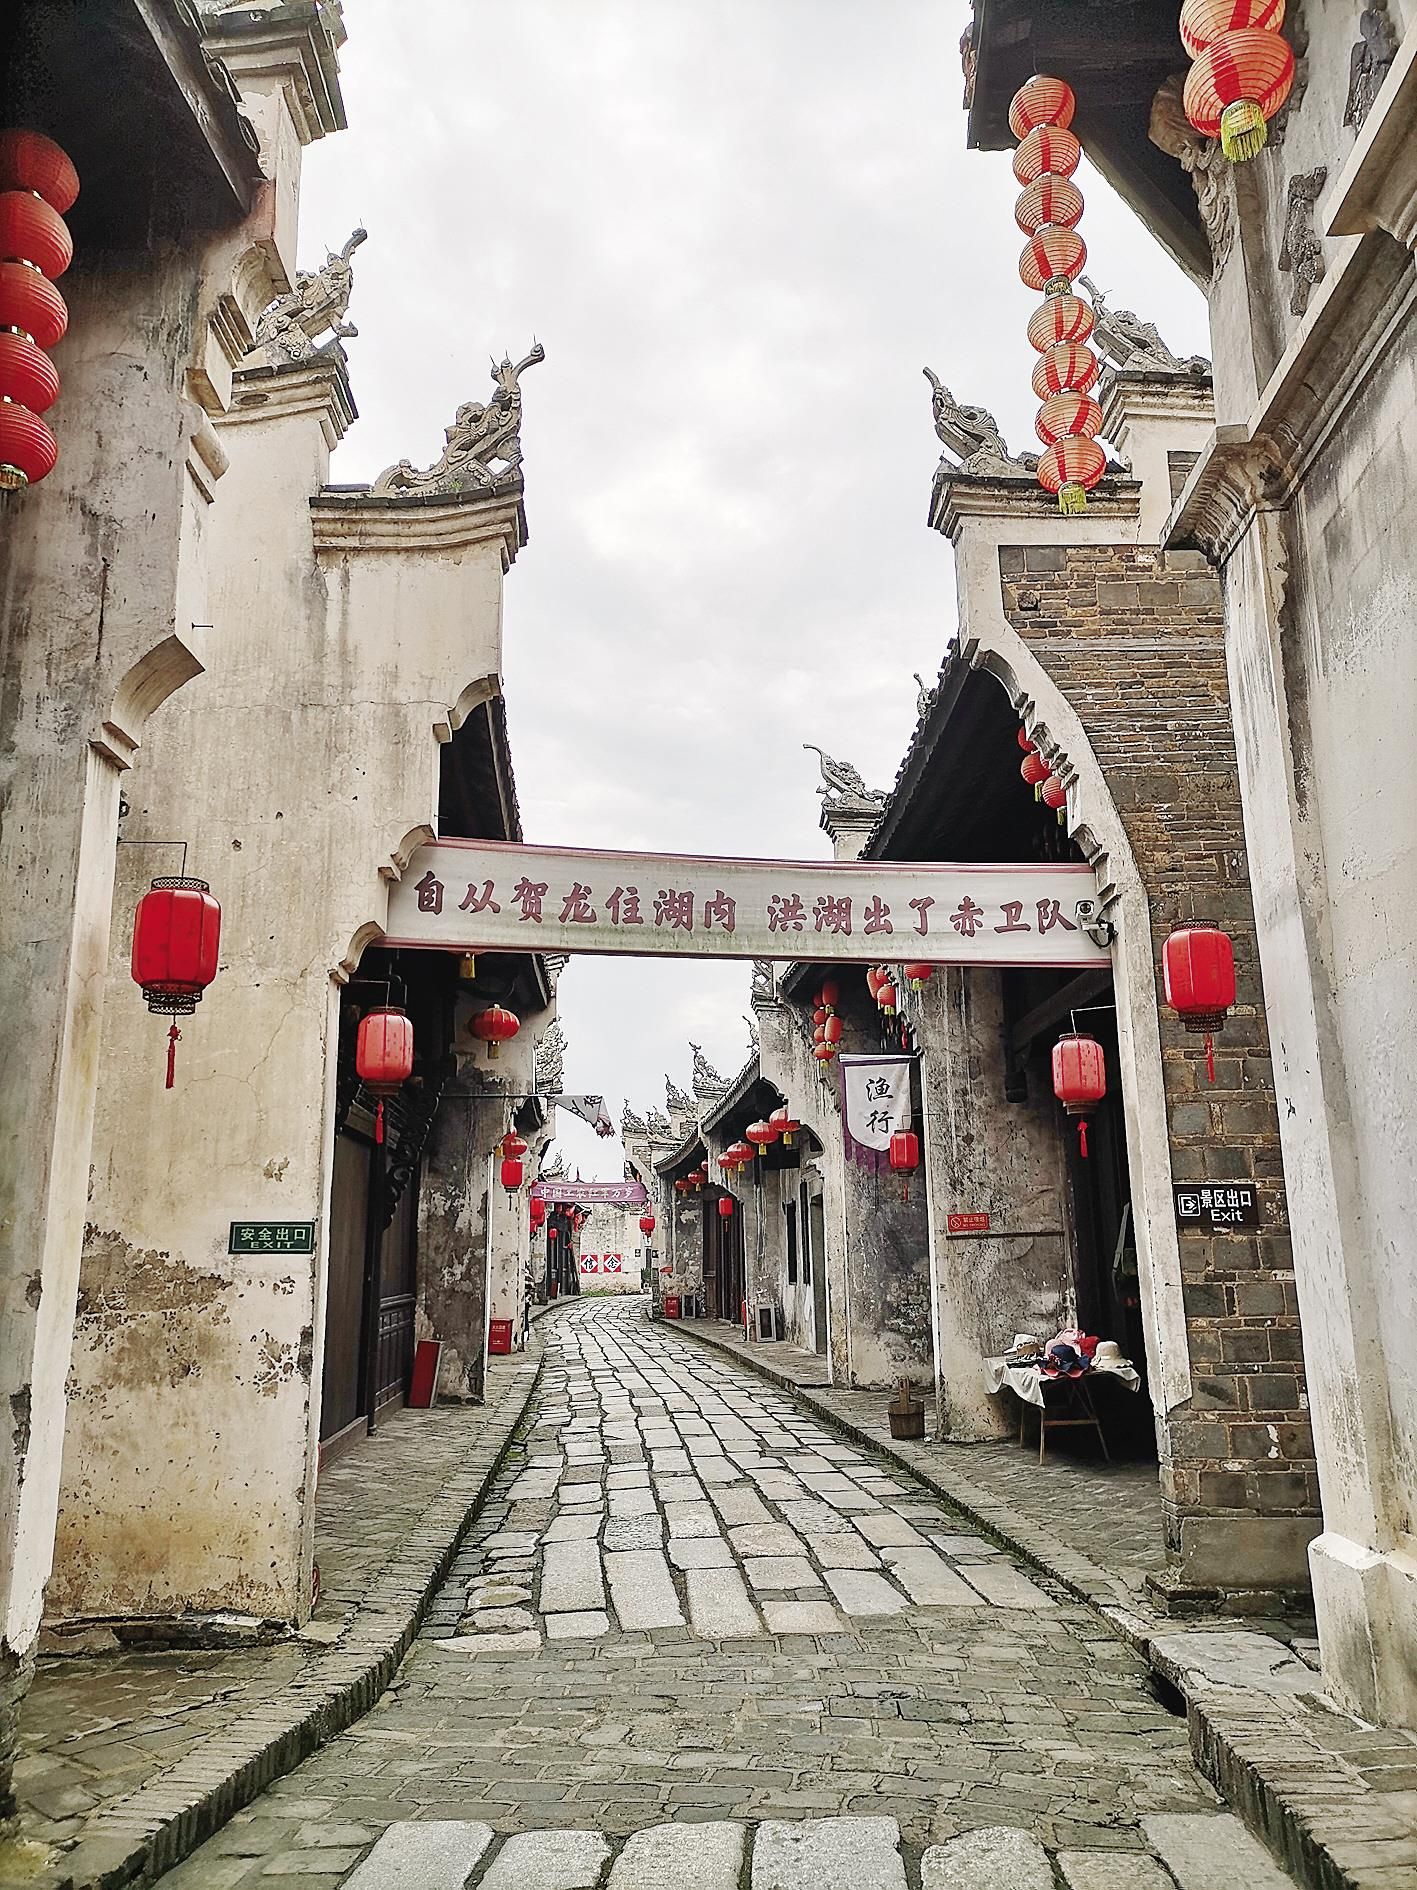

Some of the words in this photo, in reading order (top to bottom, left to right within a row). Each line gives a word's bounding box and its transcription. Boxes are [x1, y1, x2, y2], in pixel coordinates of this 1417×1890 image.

[414, 870, 737, 933] 自从贺龙住湖内
[767, 892, 1078, 937] 洪湖出了赤卫队
[865, 1076, 895, 1135] 渔行
[1200, 1188, 1252, 1209] 景区出口
[1210, 1208, 1244, 1222] Exit
[240, 1227, 306, 1241] 安全出口
[250, 1241, 295, 1249] EXIT
